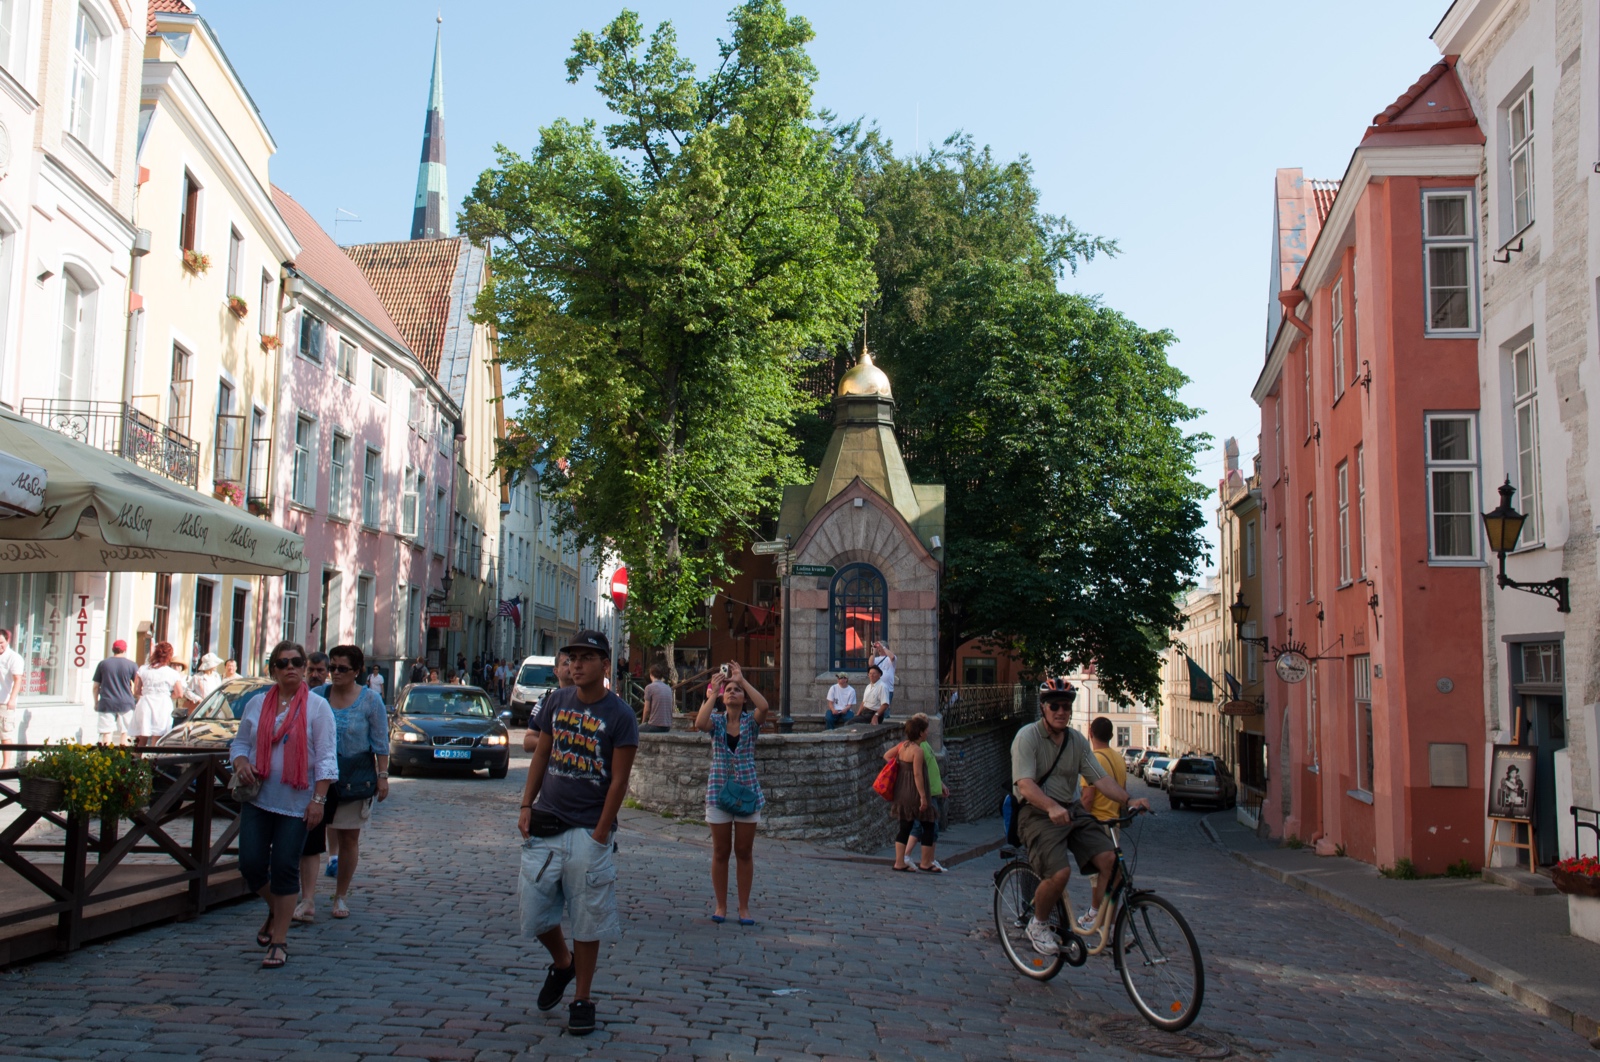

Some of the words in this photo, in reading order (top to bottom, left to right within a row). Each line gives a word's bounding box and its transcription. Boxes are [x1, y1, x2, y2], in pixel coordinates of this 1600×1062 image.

[74, 595, 90, 667] TATTOO
[1271, 641, 1307, 658] Antiik
[555, 709, 602, 735] NEW
[552, 728, 600, 756] YORK
